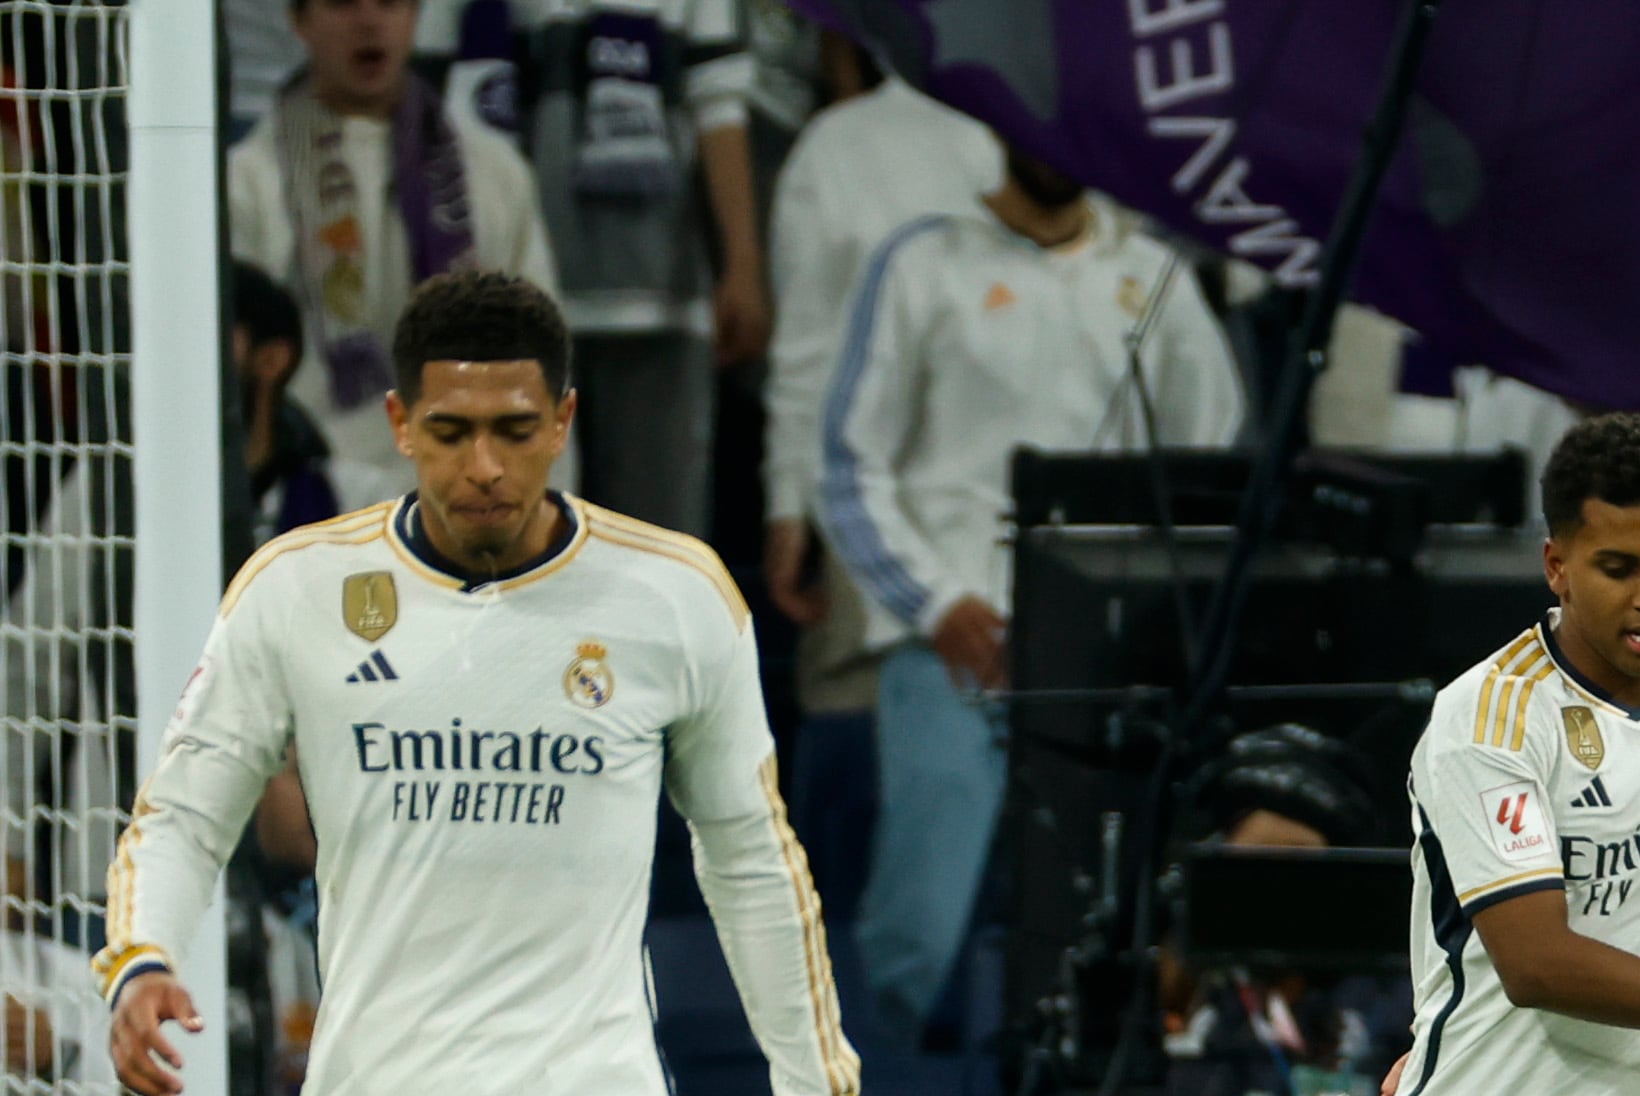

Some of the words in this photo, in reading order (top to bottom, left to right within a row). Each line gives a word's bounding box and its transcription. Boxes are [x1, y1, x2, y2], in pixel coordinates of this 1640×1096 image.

[352, 718, 605, 775] Emirates
[392, 781, 441, 822] FLY
[452, 782, 566, 825] BETTER
[1504, 834, 1545, 853] LALIGA
